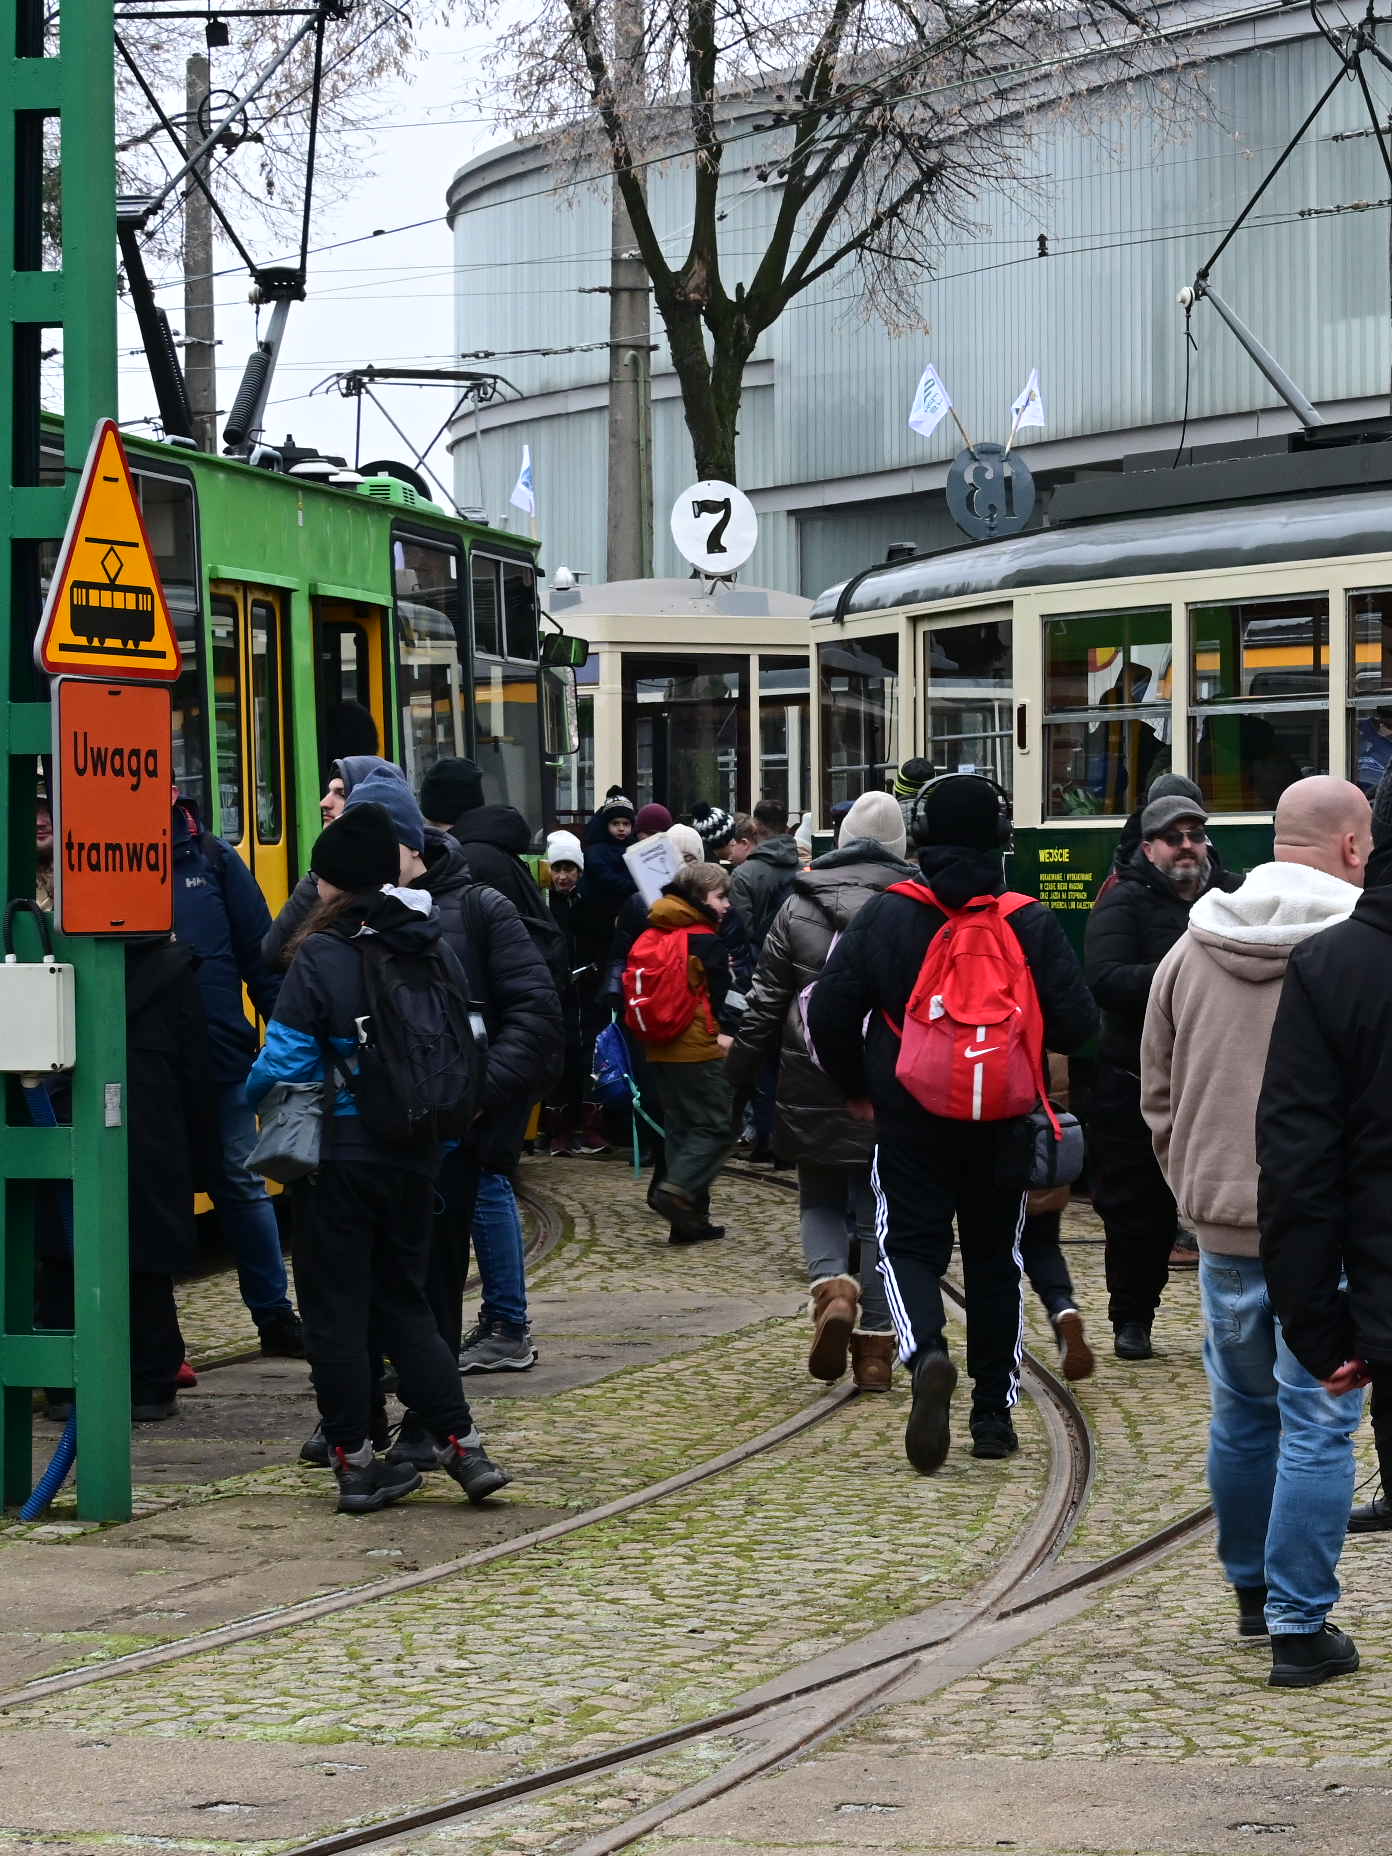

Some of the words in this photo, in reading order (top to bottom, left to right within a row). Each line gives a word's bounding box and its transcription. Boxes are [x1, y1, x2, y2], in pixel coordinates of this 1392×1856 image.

[691, 497, 732, 554] 7
[73, 731, 158, 791] Uwaga
[65, 828, 168, 885] tramwaj
[1039, 846, 1070, 862] WEJŚCIE
